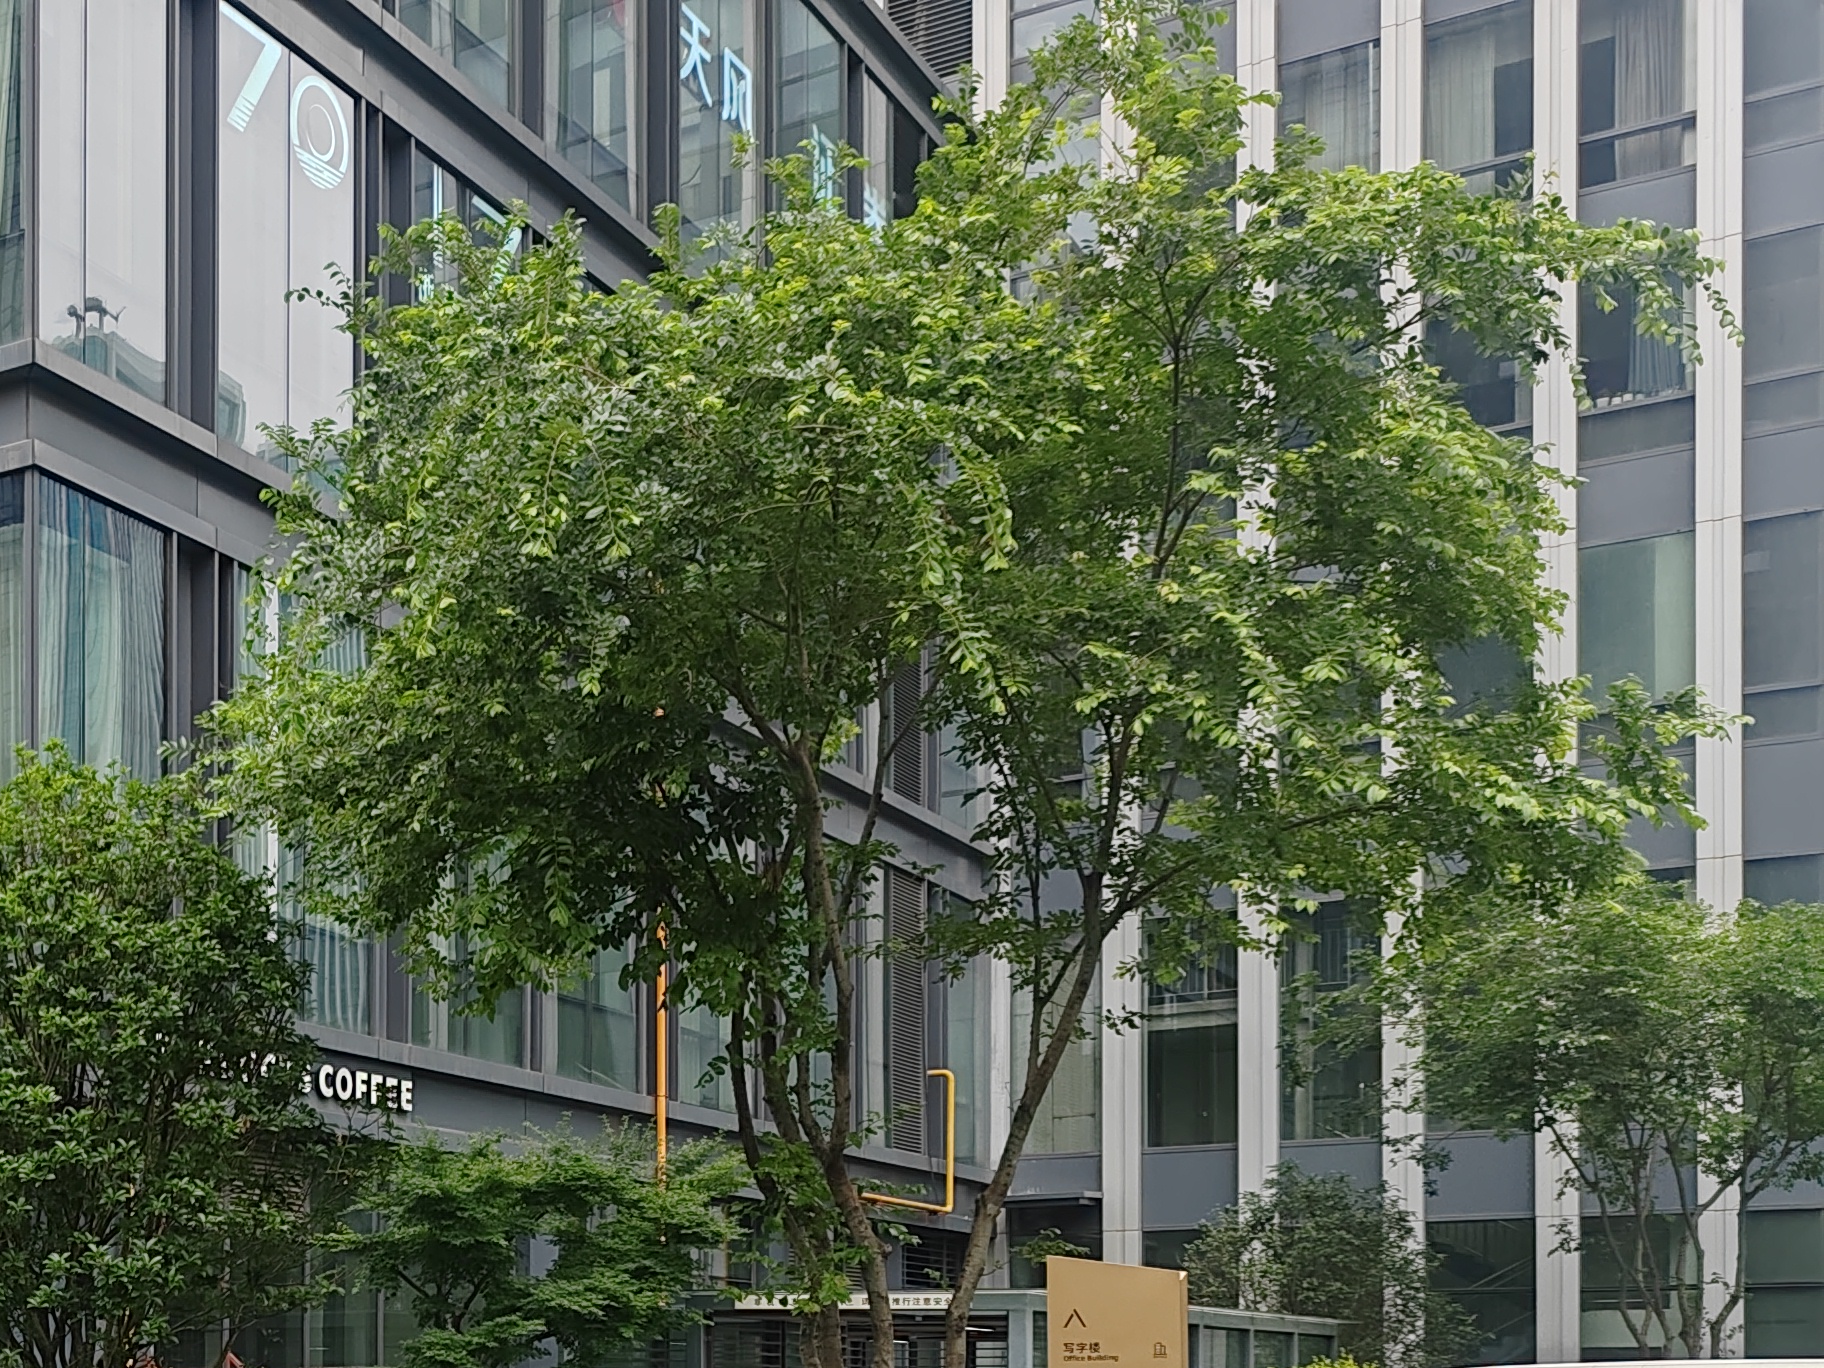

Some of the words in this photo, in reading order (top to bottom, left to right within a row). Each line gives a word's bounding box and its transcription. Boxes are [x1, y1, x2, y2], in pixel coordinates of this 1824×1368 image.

[318, 1064, 413, 1112] COFFEE
[1063, 1342, 1101, 1354] 写字楼
